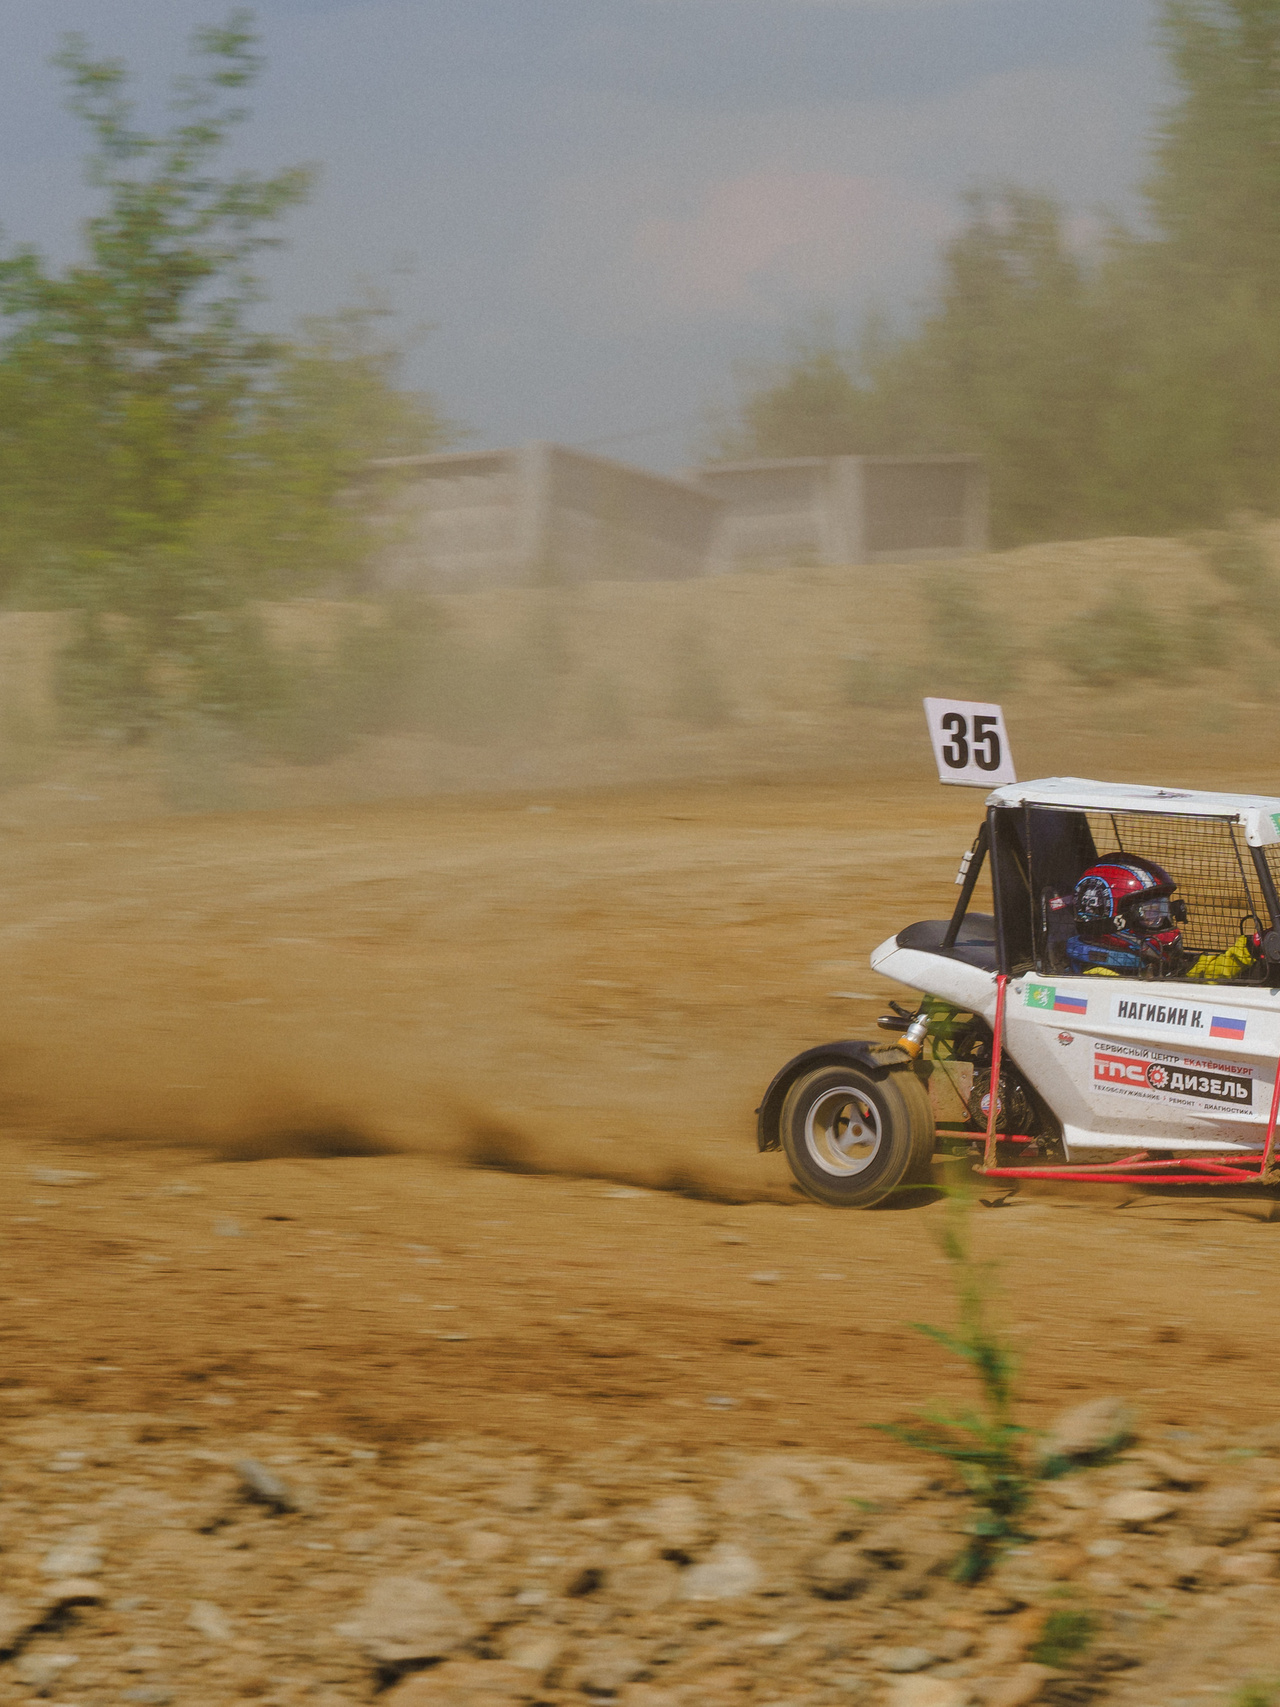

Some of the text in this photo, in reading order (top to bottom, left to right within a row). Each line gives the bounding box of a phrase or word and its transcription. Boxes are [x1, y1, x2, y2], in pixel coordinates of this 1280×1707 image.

[942, 712, 1001, 771] 35
[1117, 1000, 1204, 1029] НАГИБИН К.
[1094, 1042, 1254, 1076] СЕРВИСНЫЙ ЦЕНТР ЕКАТЕРИНБУРГ
[1170, 1072, 1249, 1099] ДИЗЕЛЬ
[1168, 1097, 1196, 1107] РЕМОНТ
[1203, 1103, 1254, 1116] ДИАГНОСТИКА
